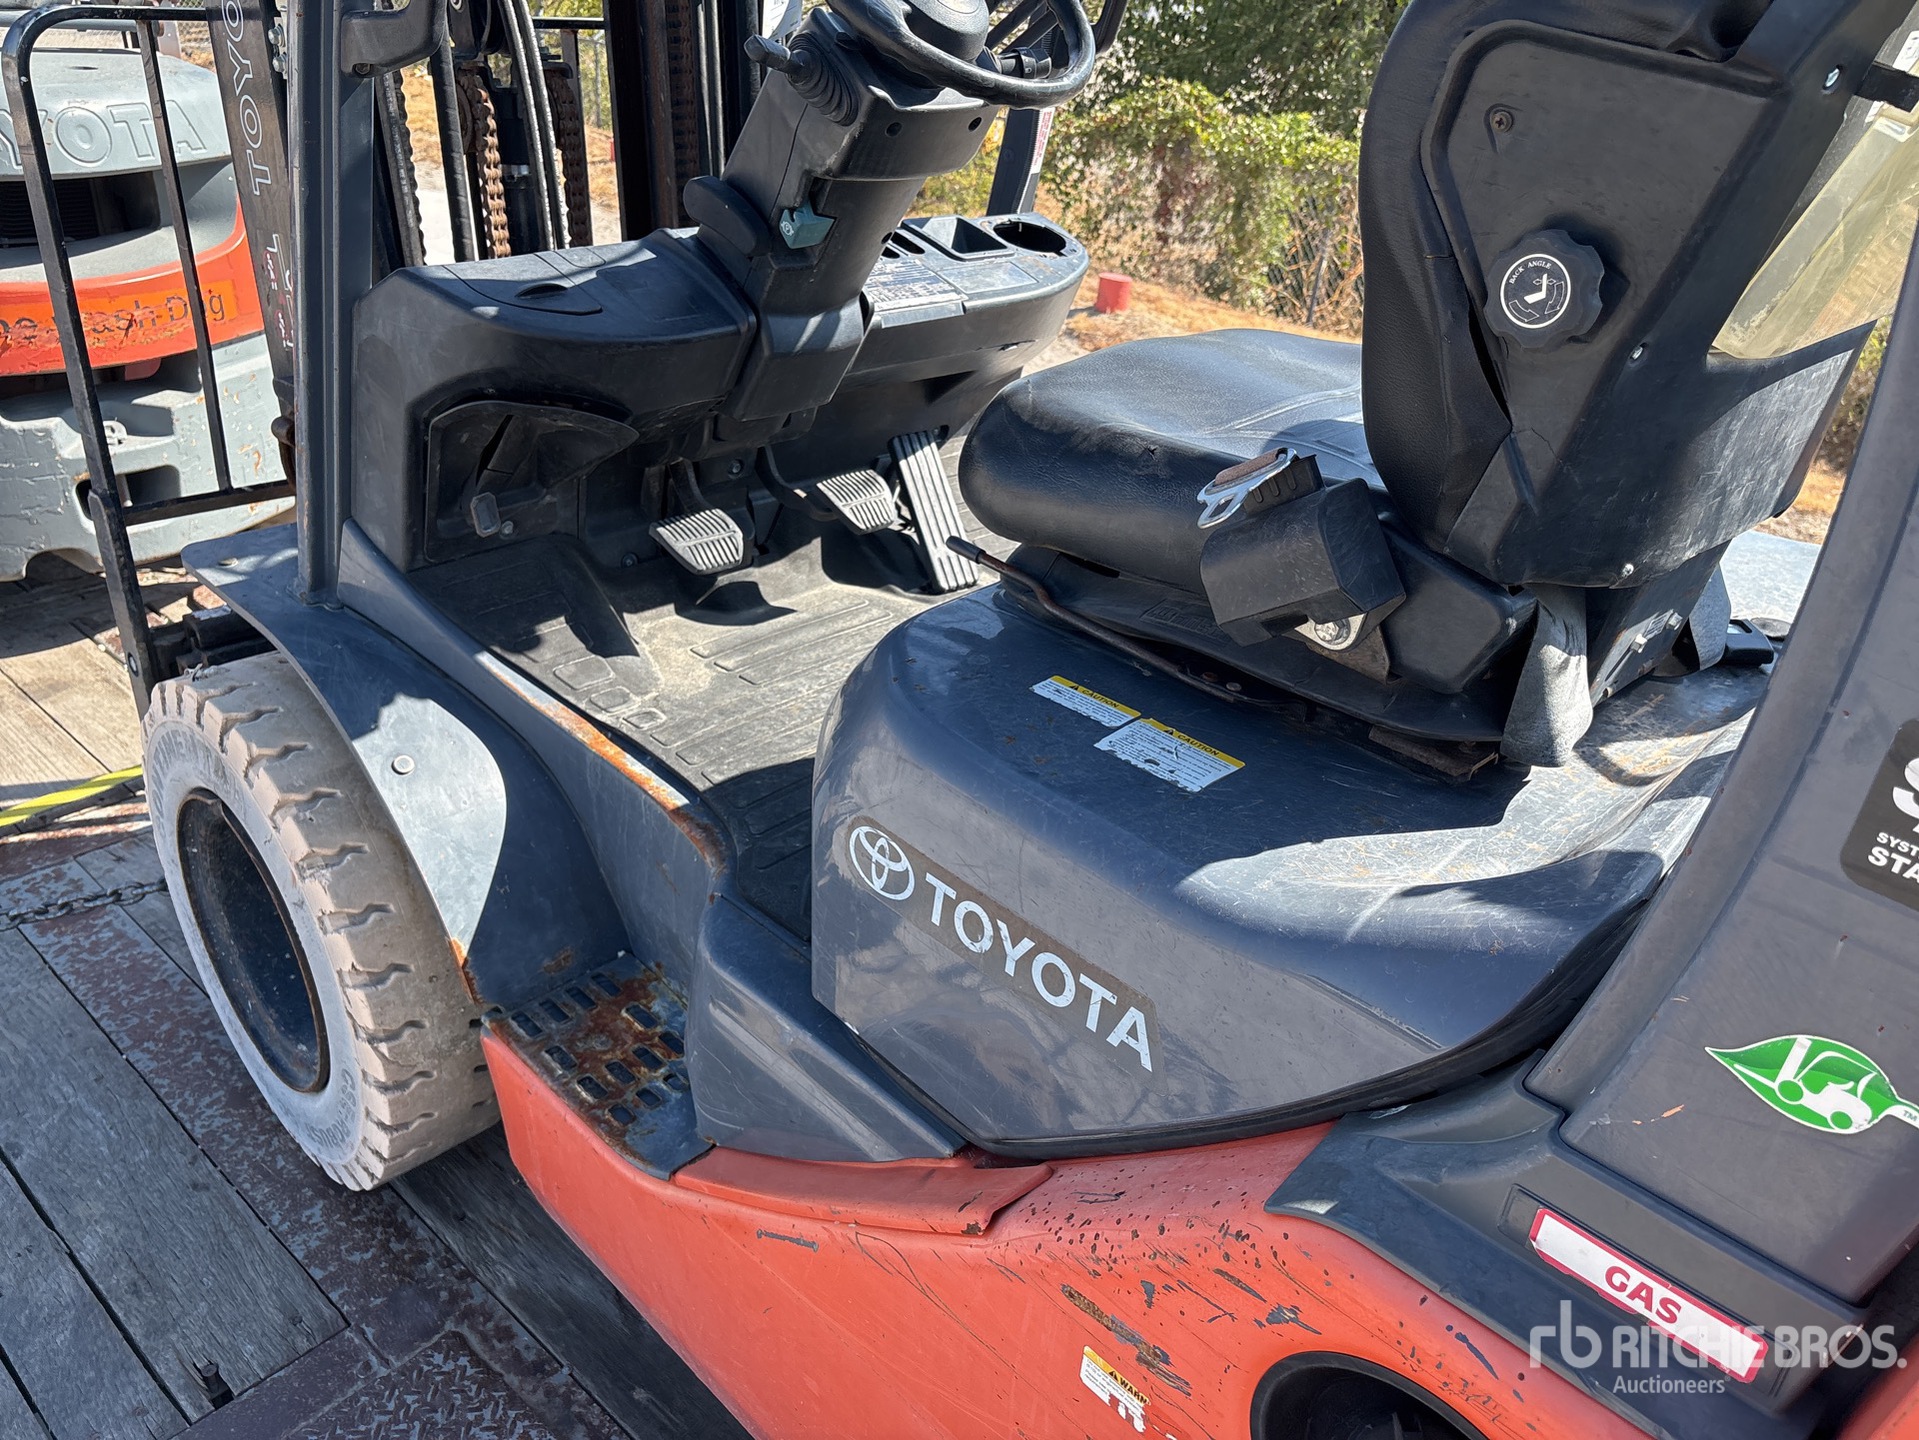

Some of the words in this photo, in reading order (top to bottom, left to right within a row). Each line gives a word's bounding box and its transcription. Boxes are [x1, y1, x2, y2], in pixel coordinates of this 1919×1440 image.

[1509, 265, 1525, 284] BACK
[1527, 260, 1551, 269] ANGLE
[165, 294, 225, 321] Dg
[1081, 688, 1120, 708] CAUTION
[1177, 734, 1220, 756] CAUTION
[925, 872, 1153, 1072] TOYOTA
[1604, 1265, 1682, 1324] GAS
